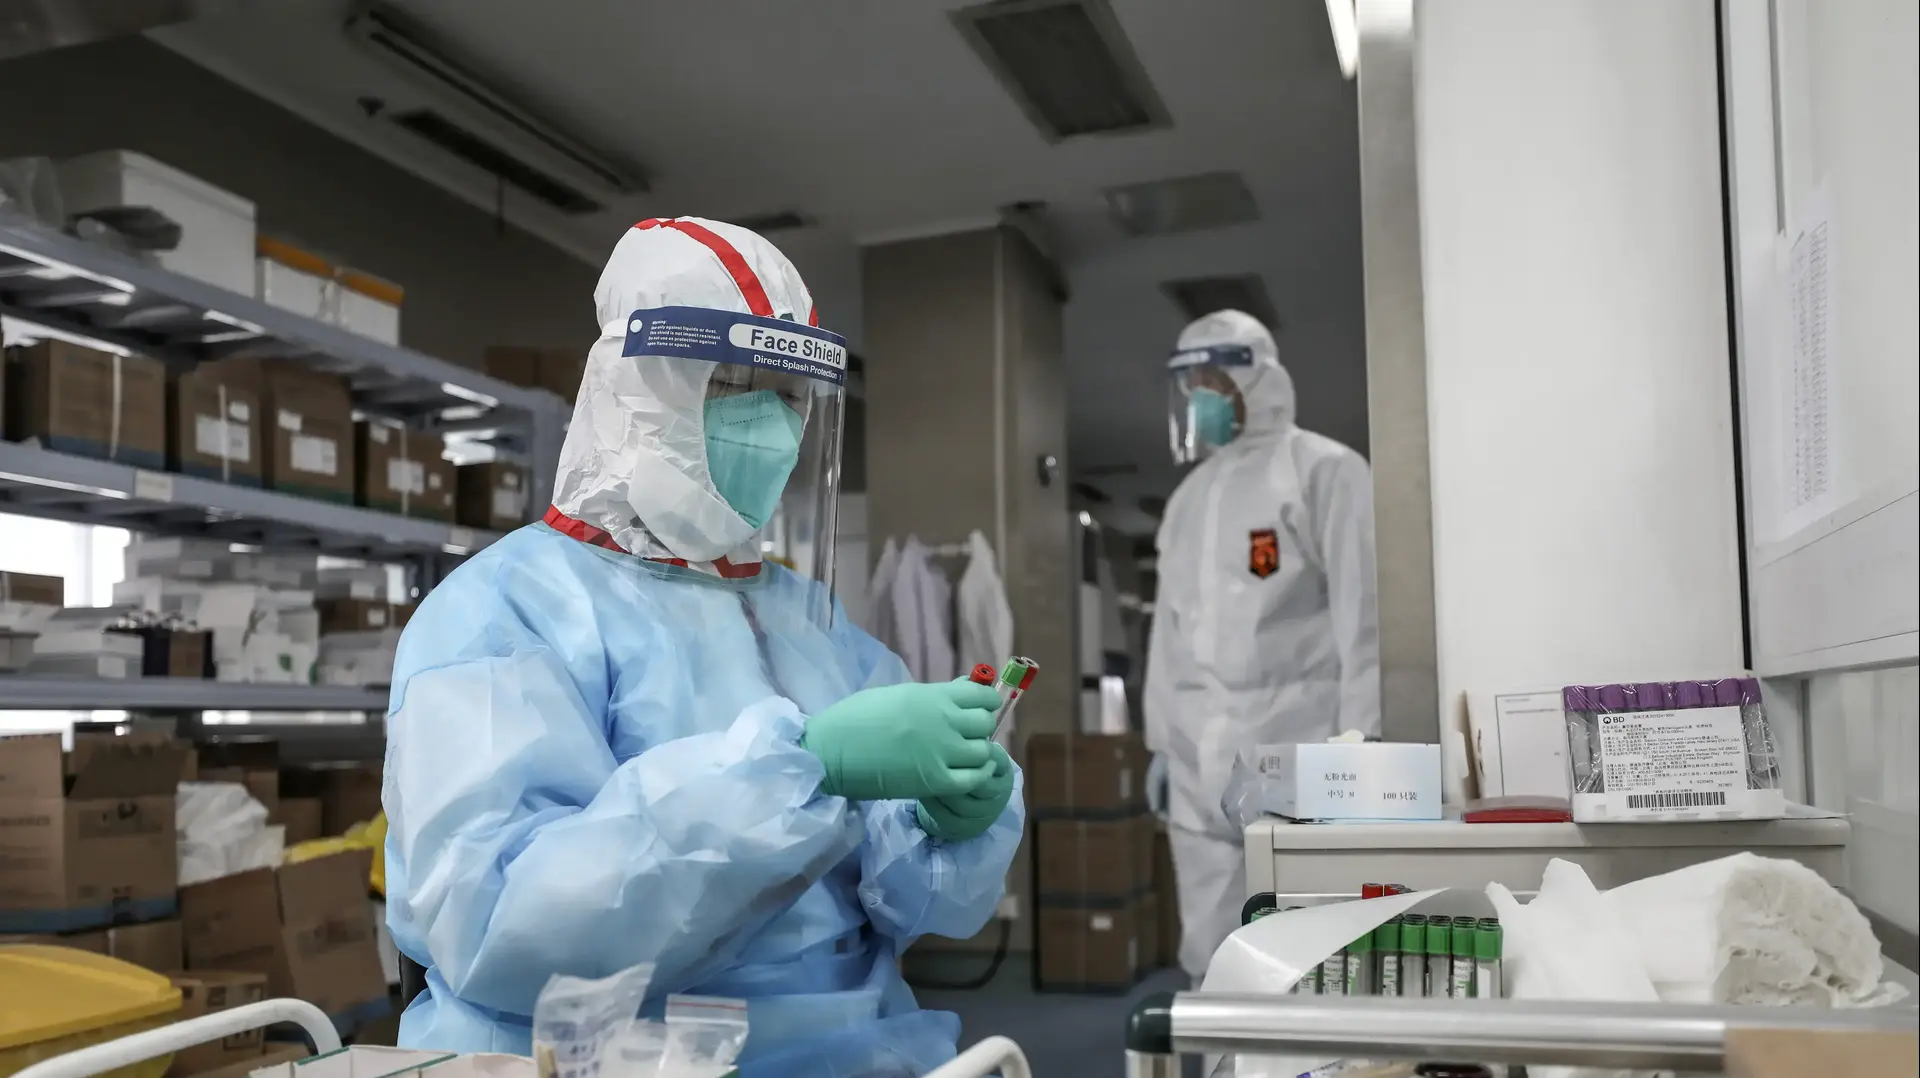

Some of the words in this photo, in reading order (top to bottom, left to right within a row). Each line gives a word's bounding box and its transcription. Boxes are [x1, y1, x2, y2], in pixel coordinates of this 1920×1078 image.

[751, 329, 798, 353] Face
[802, 339, 842, 366] Shield
[754, 354, 781, 367] Direct
[782, 359, 809, 372] Splash
[810, 365, 838, 380] Protection
[1328, 789, 1344, 799] 中号
[1383, 792, 1397, 800] 100
[1399, 792, 1418, 800] 只装
